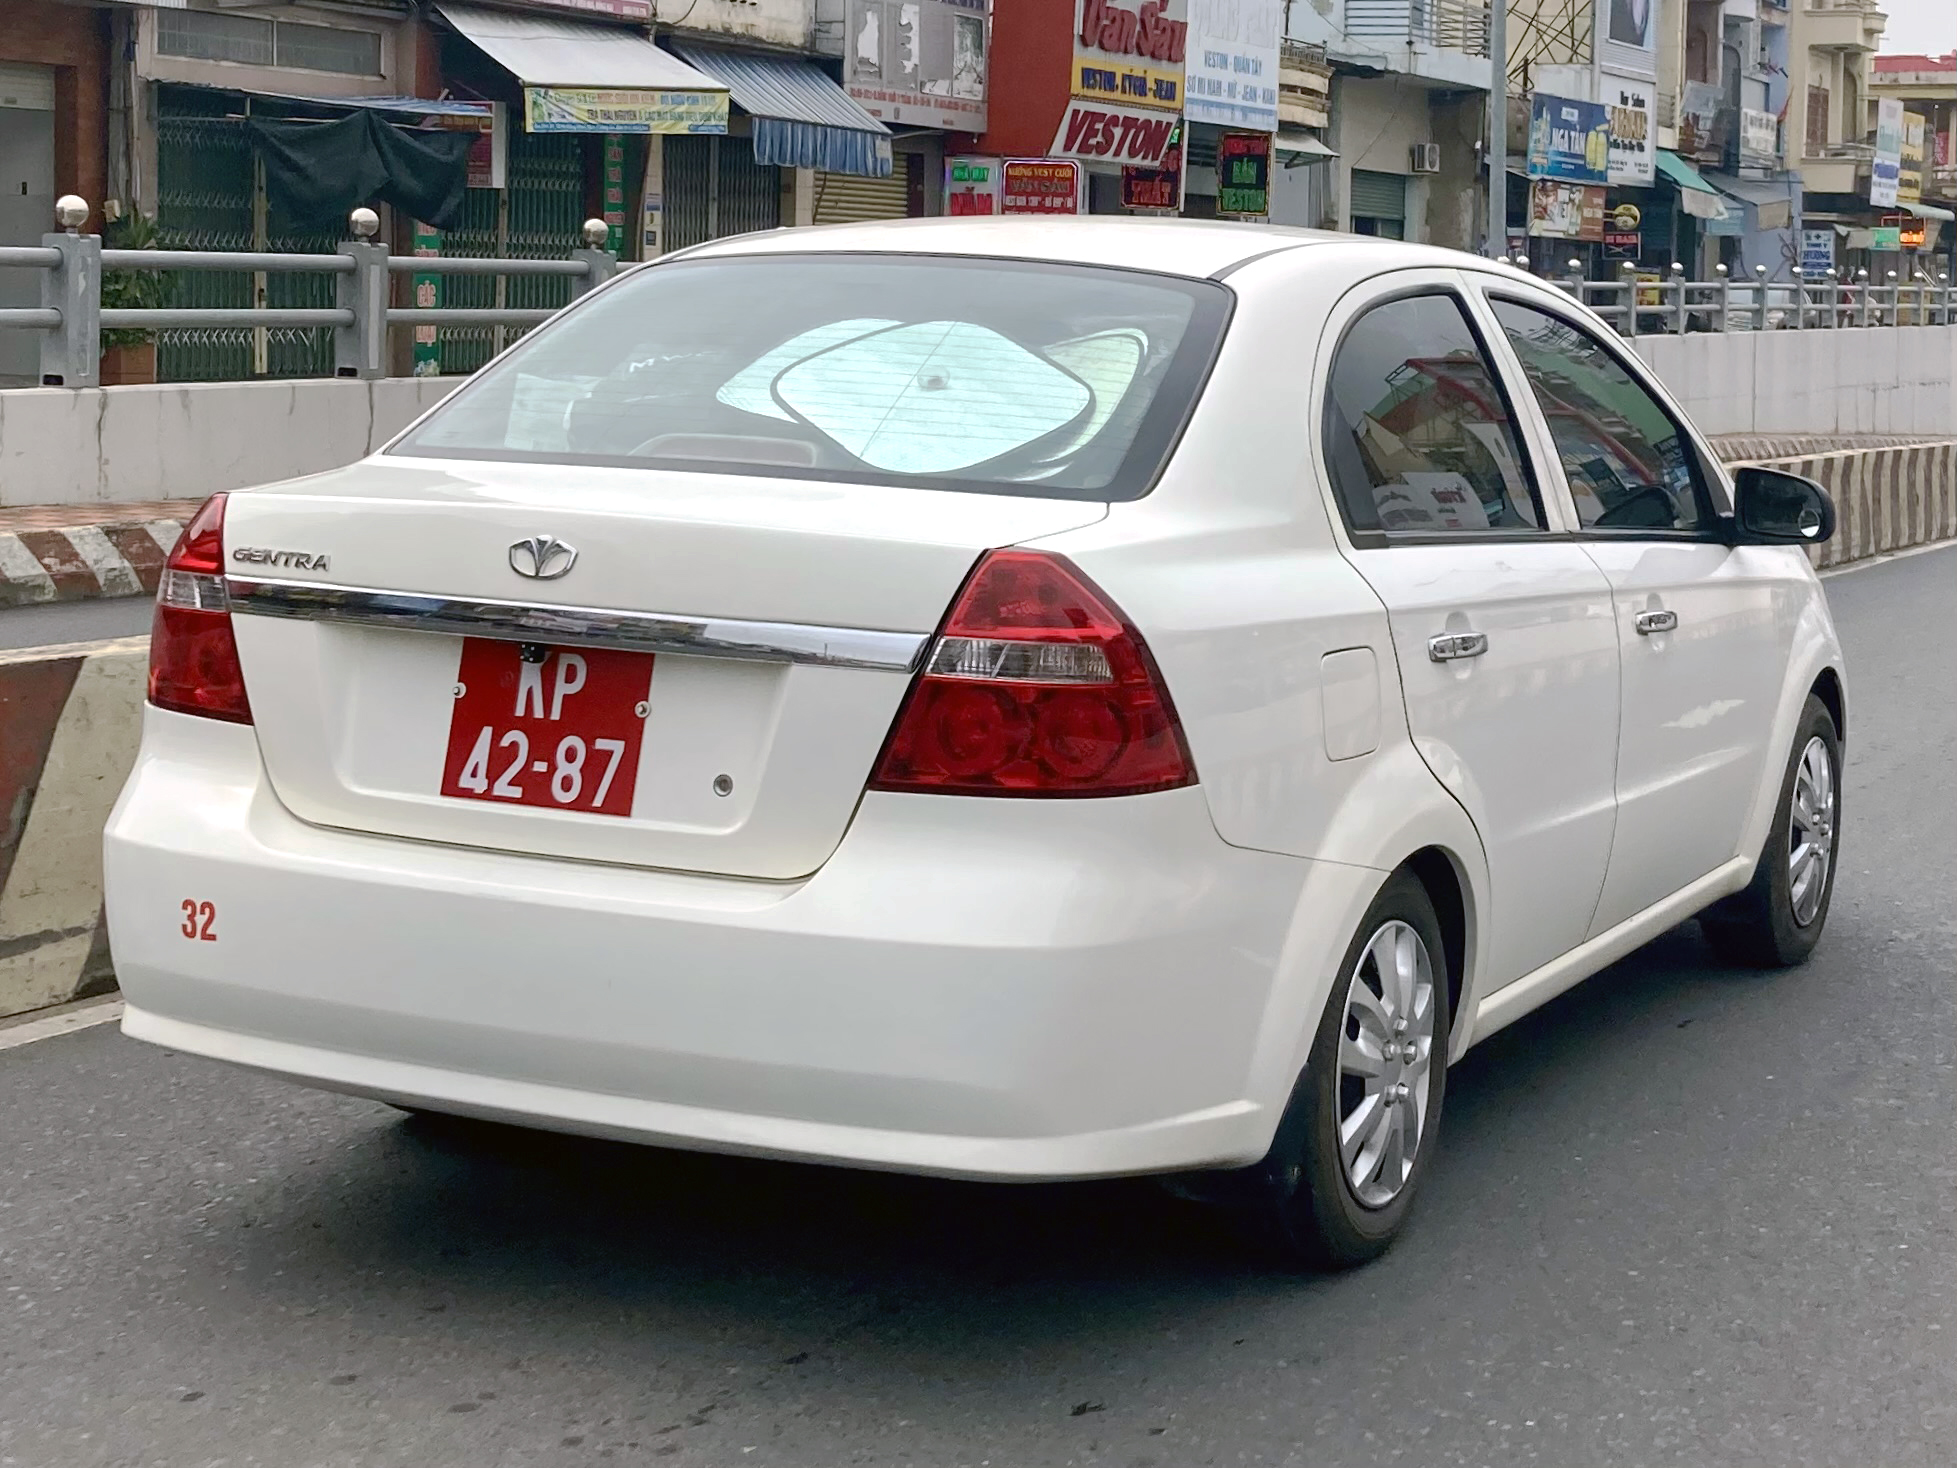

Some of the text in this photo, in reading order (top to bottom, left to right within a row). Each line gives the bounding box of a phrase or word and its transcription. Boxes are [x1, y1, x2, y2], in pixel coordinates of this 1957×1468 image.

[1204, 50, 1228, 70] VESTON
[1063, 108, 1173, 161] VESTON
[233, 547, 331, 572] GENTRA
[514, 651, 588, 720] KP
[458, 726, 626, 808] 42-87
[181, 898, 217, 942] 32
